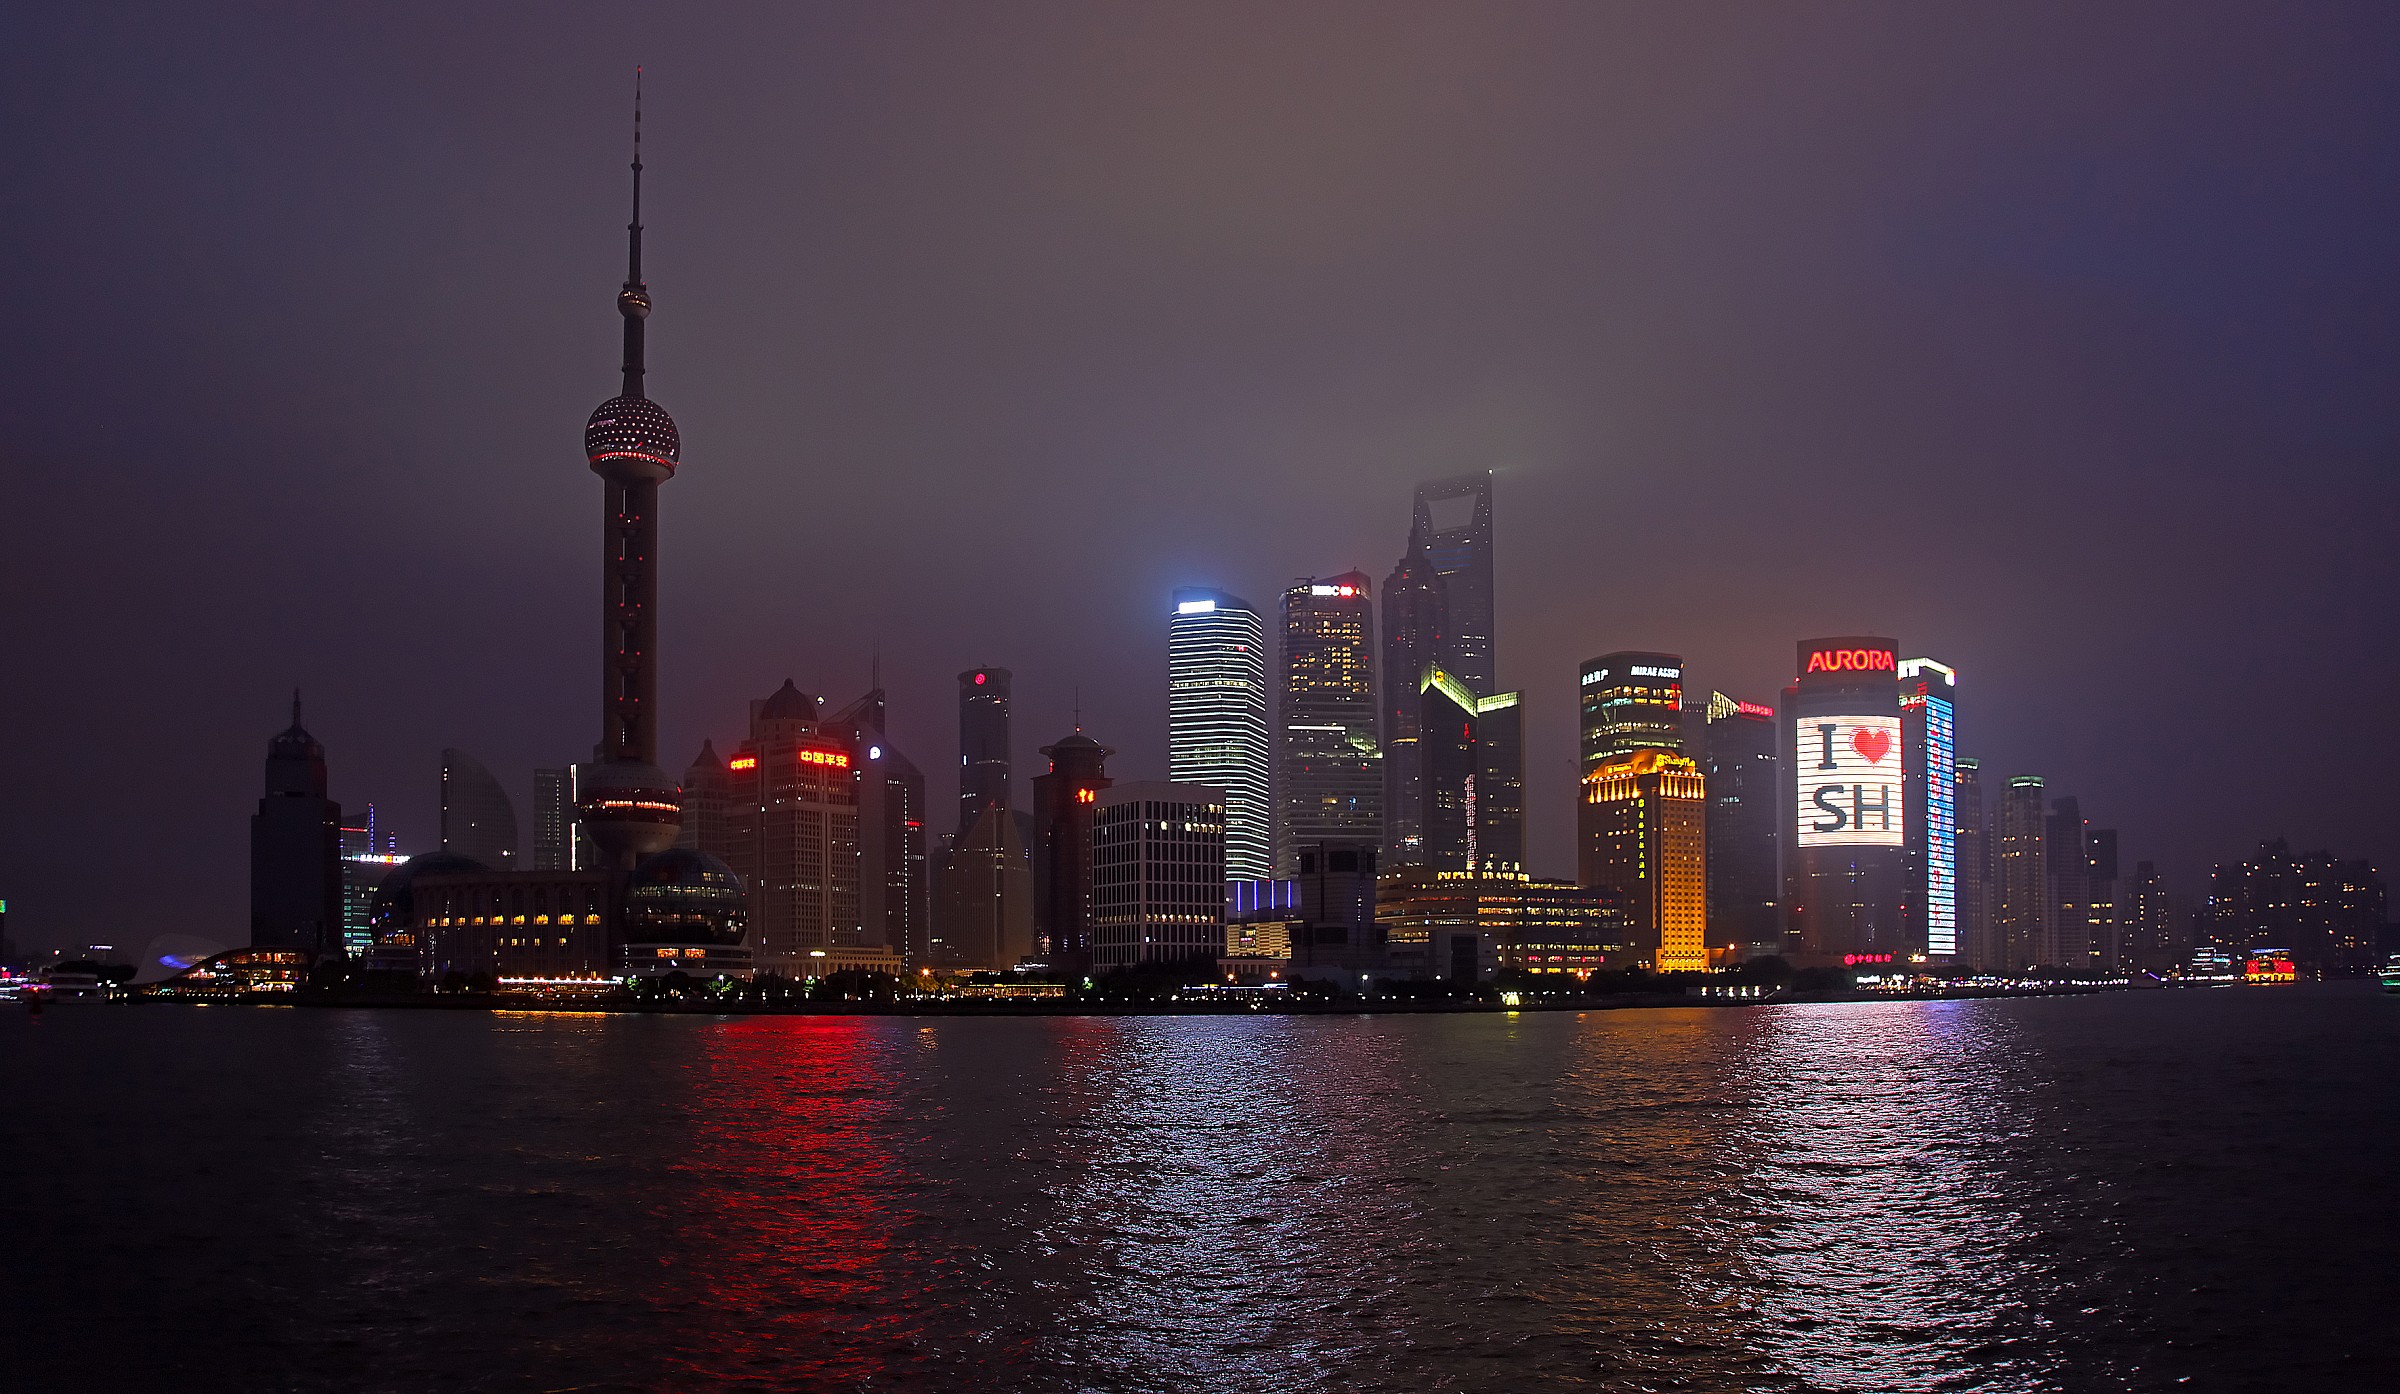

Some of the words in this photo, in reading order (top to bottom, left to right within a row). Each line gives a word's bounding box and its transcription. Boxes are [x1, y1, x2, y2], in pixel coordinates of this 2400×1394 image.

[1806, 649, 1896, 673] AURORA
[1818, 724, 1837, 769] I
[801, 751, 847, 767] 中国平安
[1813, 785, 1889, 831] SH
[1437, 871, 1474, 881] SUPER
[1482, 871, 1515, 881] BRAND
